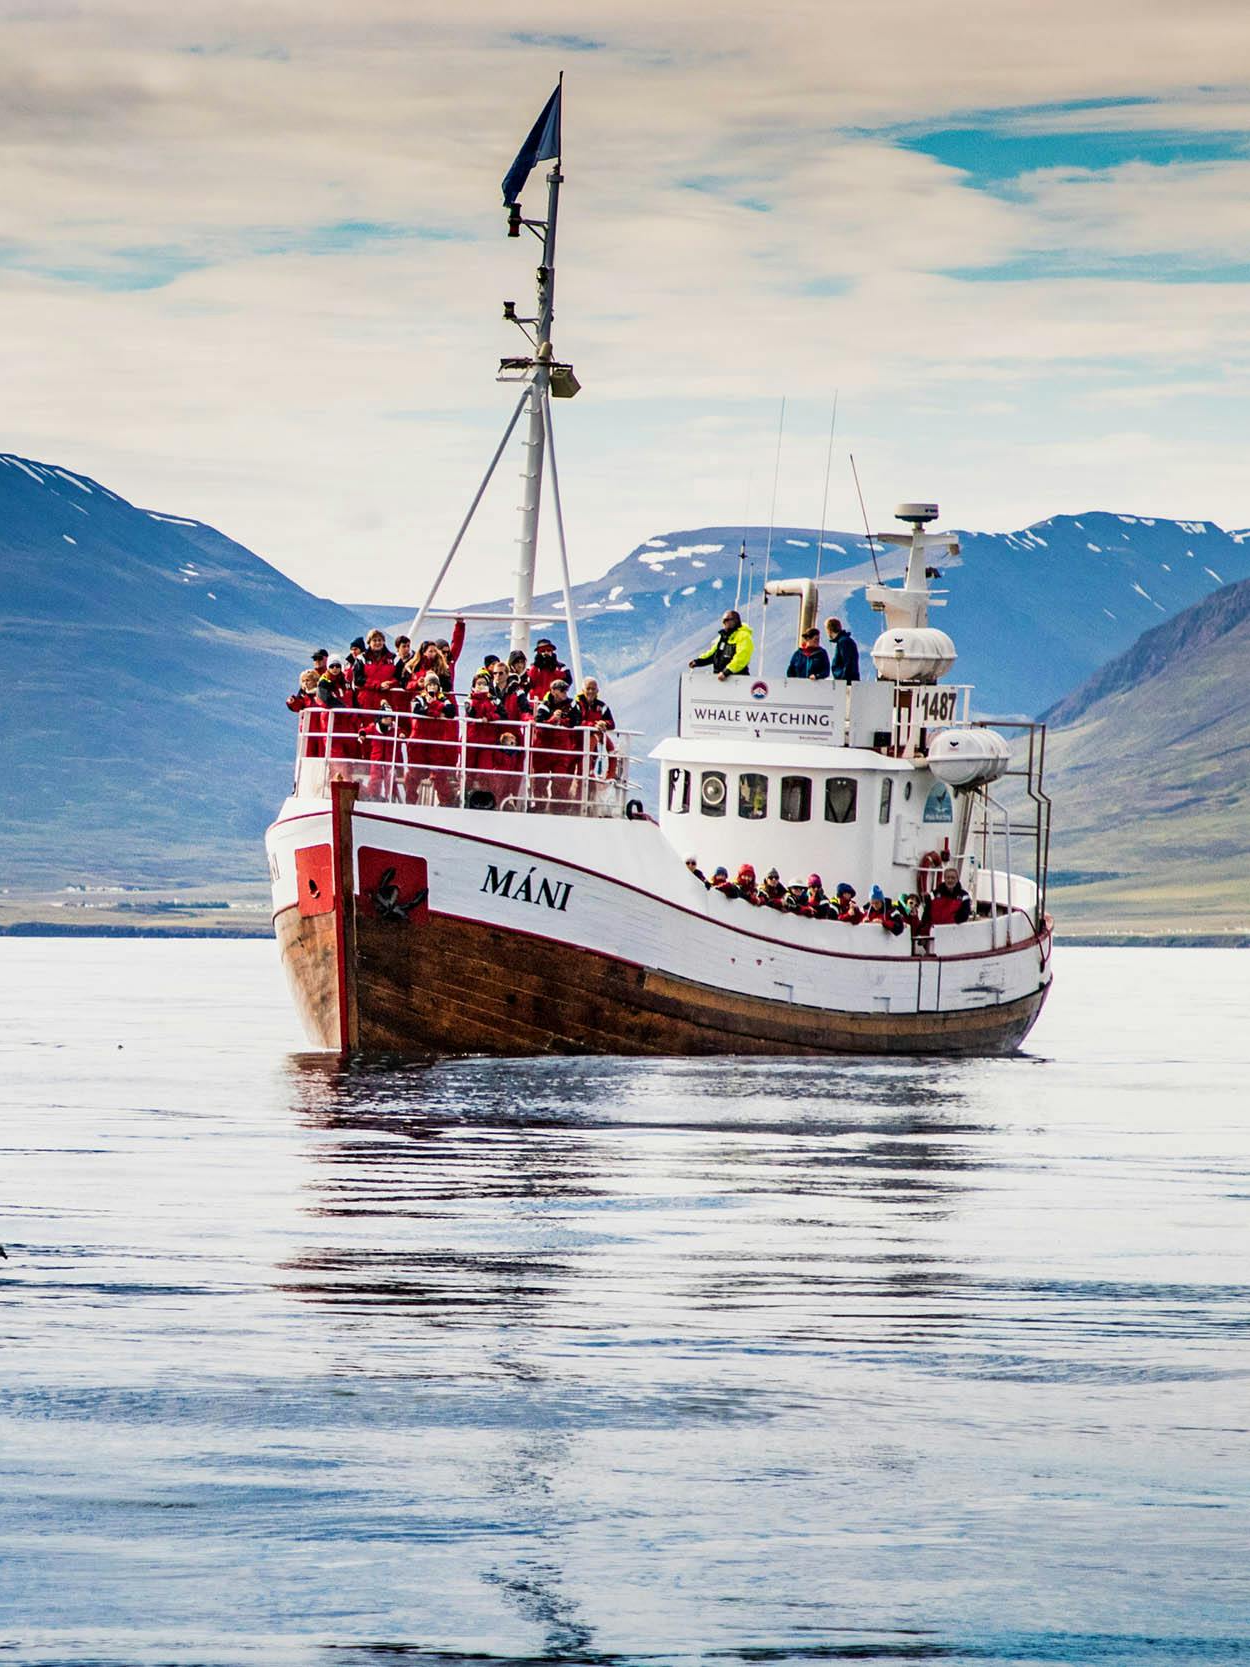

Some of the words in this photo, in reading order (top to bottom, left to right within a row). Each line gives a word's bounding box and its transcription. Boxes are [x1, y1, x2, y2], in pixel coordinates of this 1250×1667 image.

[694, 708, 741, 722] WHALE
[746, 711, 830, 727] WATCHING
[921, 692, 957, 721] 1487
[479, 864, 575, 912] MÁNI
